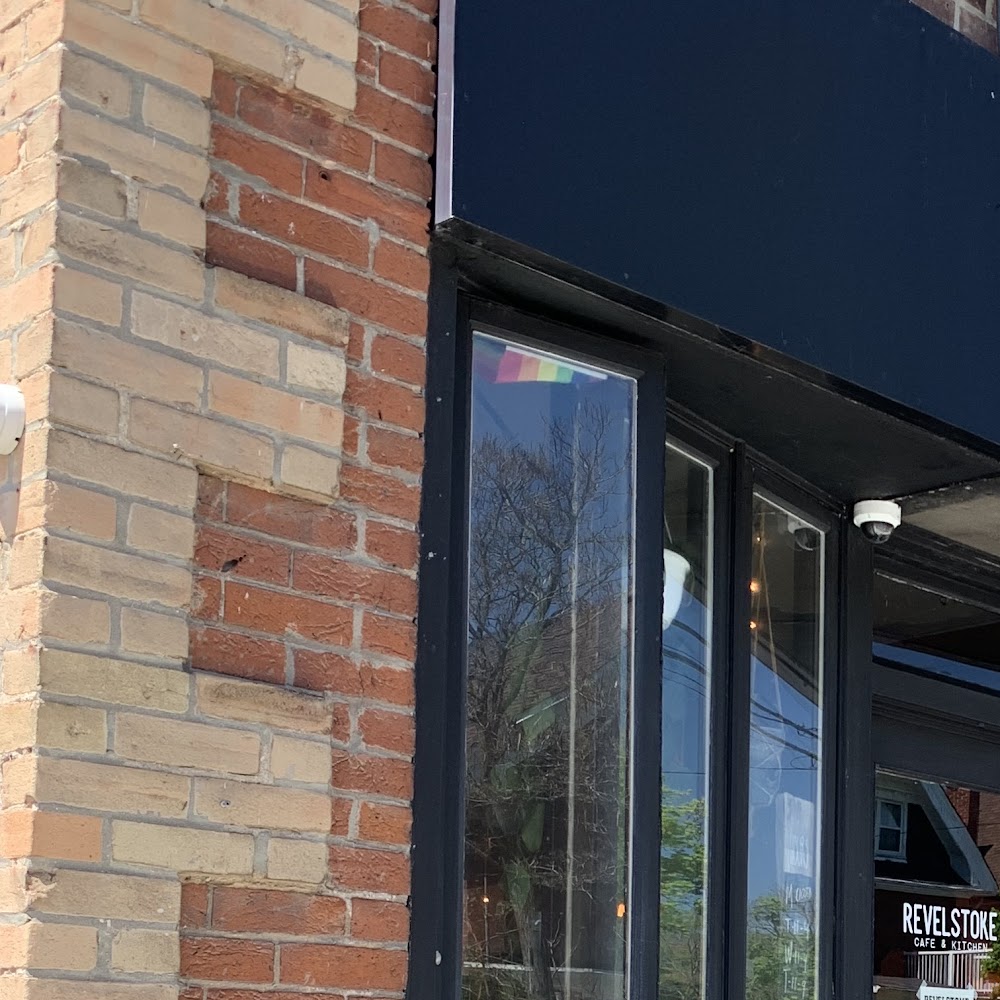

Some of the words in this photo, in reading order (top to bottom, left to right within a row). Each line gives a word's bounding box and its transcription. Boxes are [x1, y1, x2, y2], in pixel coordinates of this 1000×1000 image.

[903, 902, 998, 941] REVELSTOKE
[914, 937, 936, 949] CAFE
[941, 938, 947, 948] &
[951, 940, 988, 951] KITCHEN
